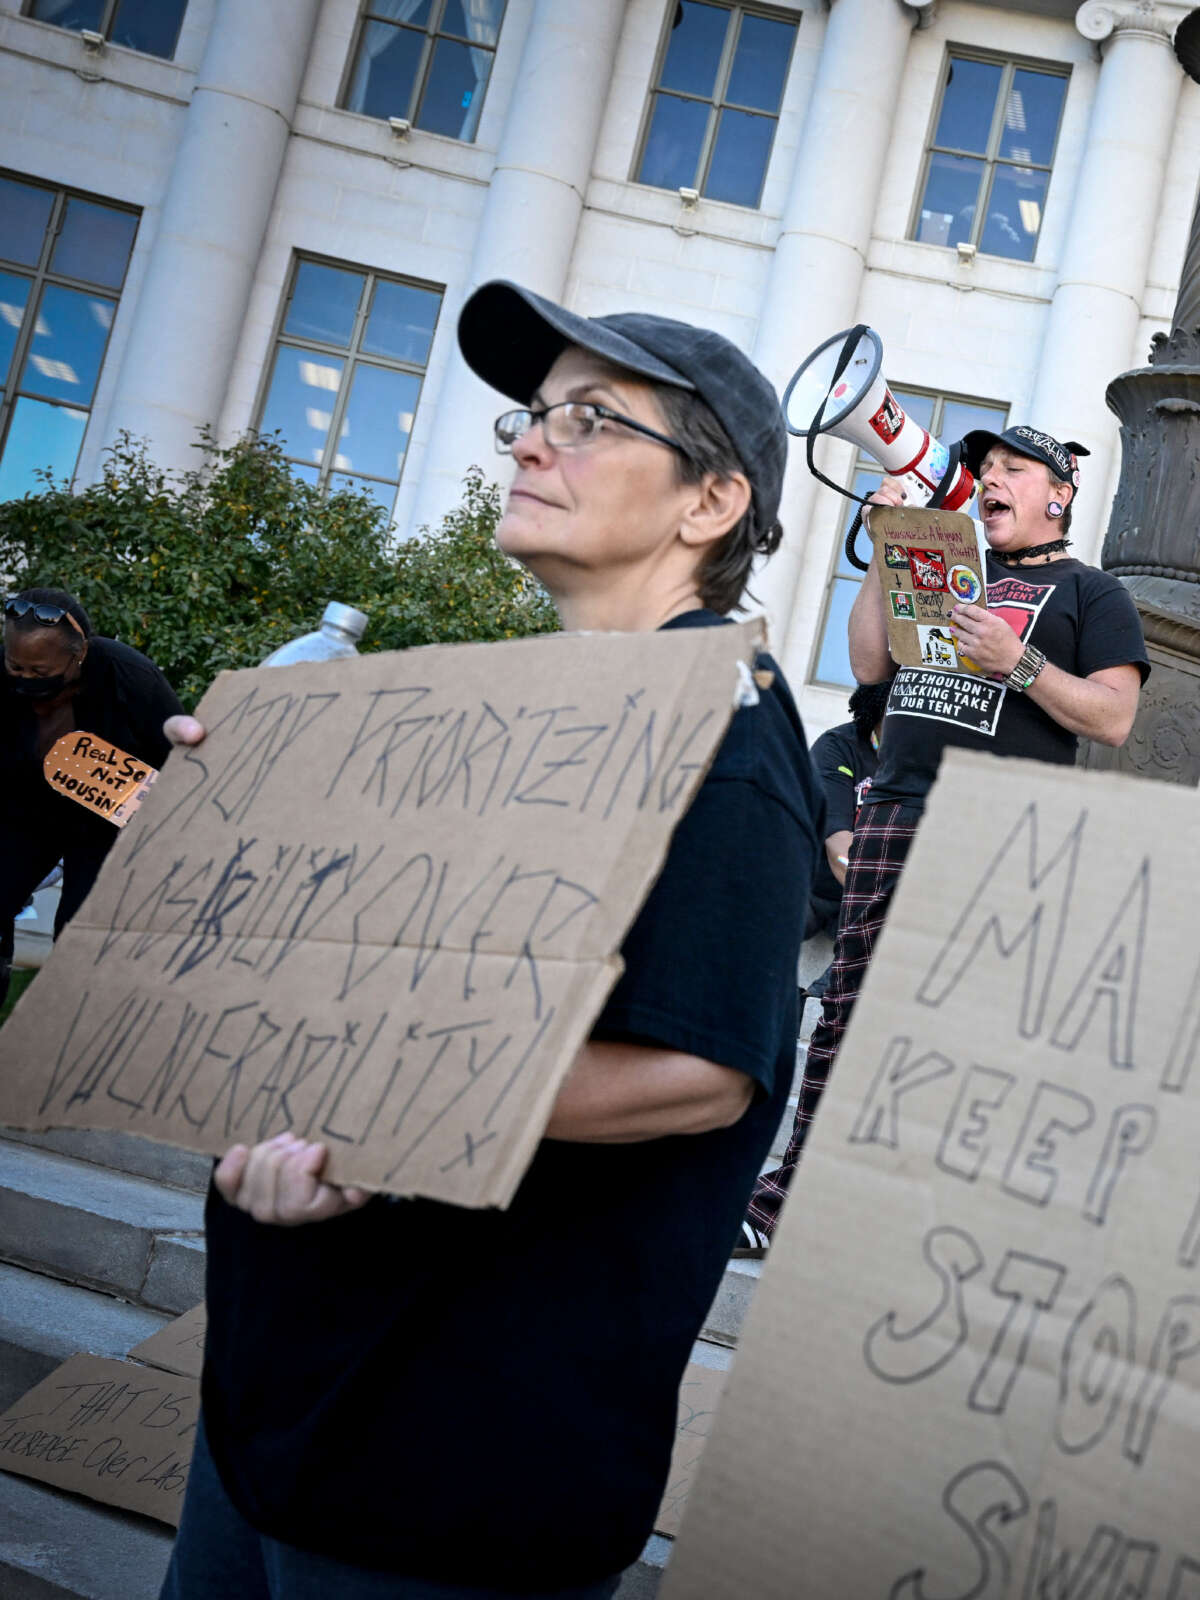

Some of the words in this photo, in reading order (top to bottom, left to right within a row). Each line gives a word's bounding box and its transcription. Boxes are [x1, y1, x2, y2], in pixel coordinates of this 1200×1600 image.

[897, 672, 918, 683] THEY
[919, 673, 997, 700] SHOULDN'T
[900, 696, 924, 709] OUR
[928, 700, 962, 717] TENT
[954, 692, 990, 713] TAKE
[124, 687, 340, 867] STOP
[340, 853, 600, 1020] OVER
[848, 1036, 1158, 1226] KEEP
[55, 1381, 159, 1431] THAT
[139, 1392, 192, 1429] IS
[136, 1451, 191, 1494] LAS
